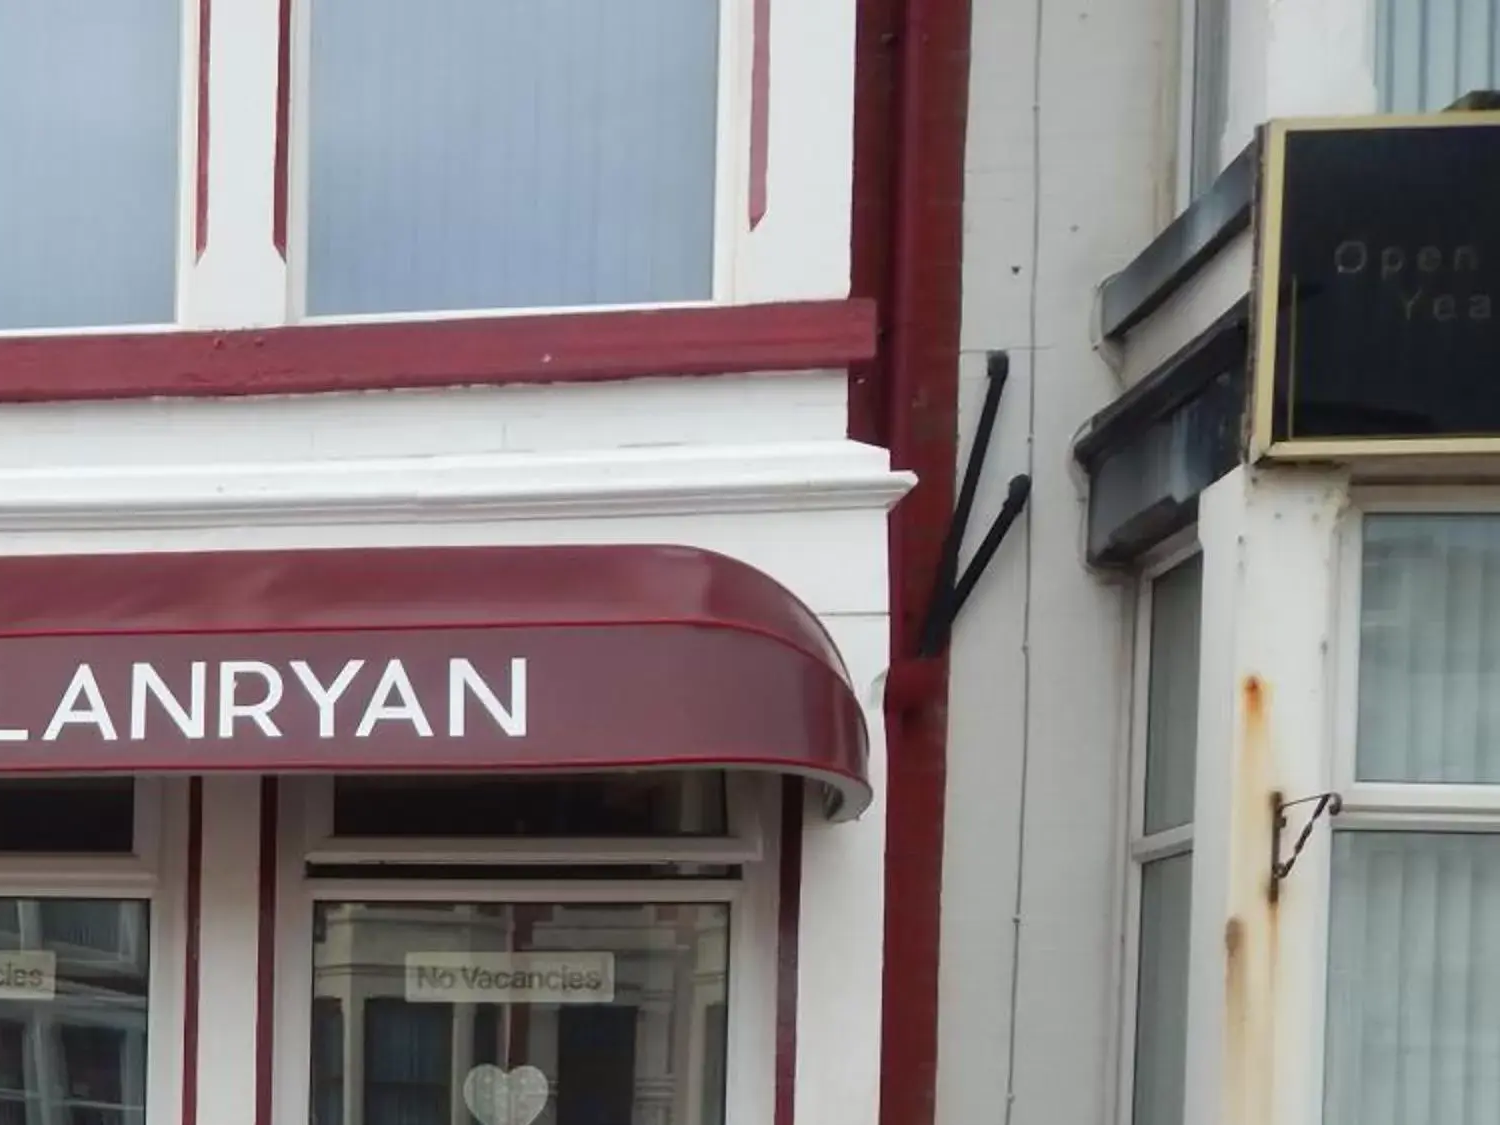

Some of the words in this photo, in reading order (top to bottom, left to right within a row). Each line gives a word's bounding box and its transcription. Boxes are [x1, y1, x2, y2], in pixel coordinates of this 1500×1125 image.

[1333, 240, 1479, 281] Open
[417, 965, 456, 990] No
[461, 964, 601, 991] Vacancies
